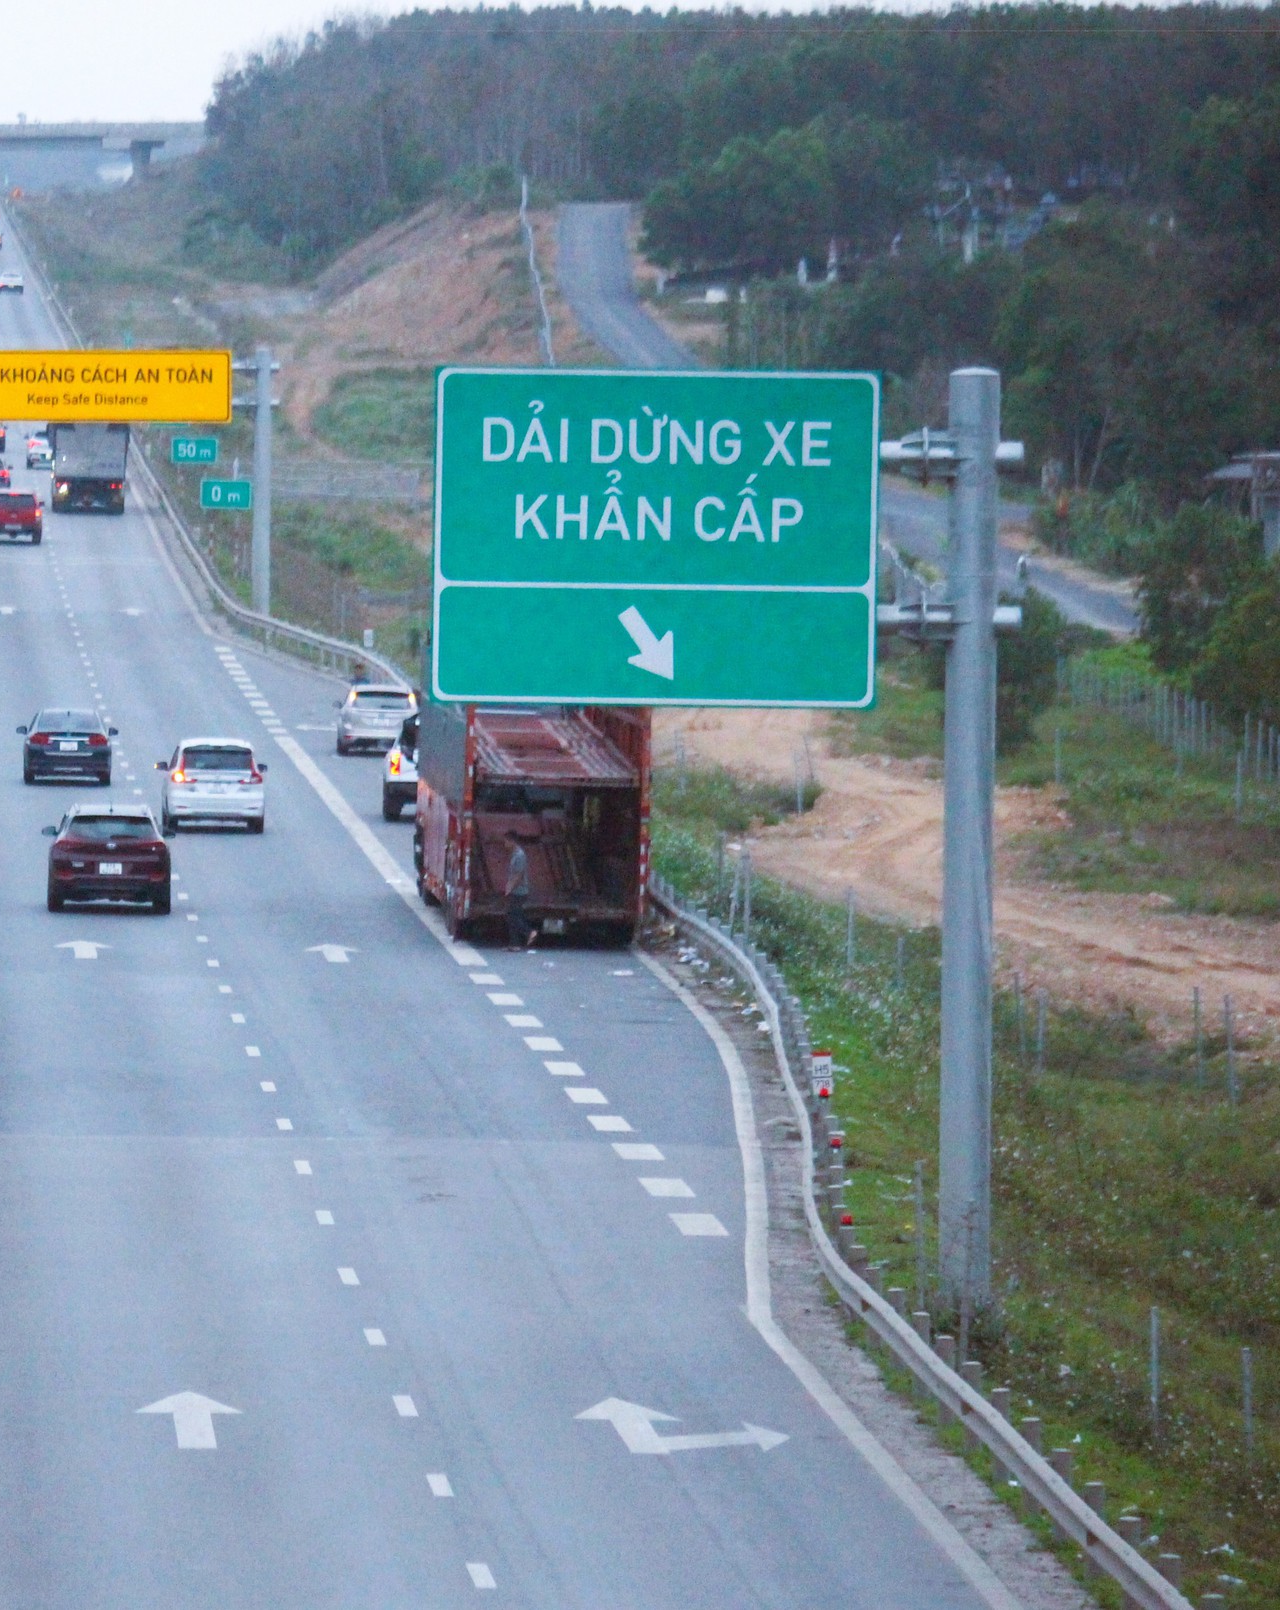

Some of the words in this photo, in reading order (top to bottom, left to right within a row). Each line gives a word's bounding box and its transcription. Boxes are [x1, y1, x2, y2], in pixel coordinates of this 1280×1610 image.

[0, 362, 75, 384] KHOẢNG
[81, 363, 127, 384] CÁCH
[134, 367, 160, 384] AN
[167, 364, 213, 384] TOÀN
[27, 392, 58, 408] Keep
[63, 392, 90, 406] Safe
[95, 392, 148, 406] Distance
[482, 400, 568, 463] DẢI
[591, 405, 742, 465] DỪNG
[762, 421, 832, 466] XE
[178, 442, 196, 458] 50
[199, 448, 211, 458] m
[211, 485, 222, 502] 0
[228, 492, 240, 503] m
[514, 470, 671, 541] KHẨN
[694, 474, 804, 543] CẤP
